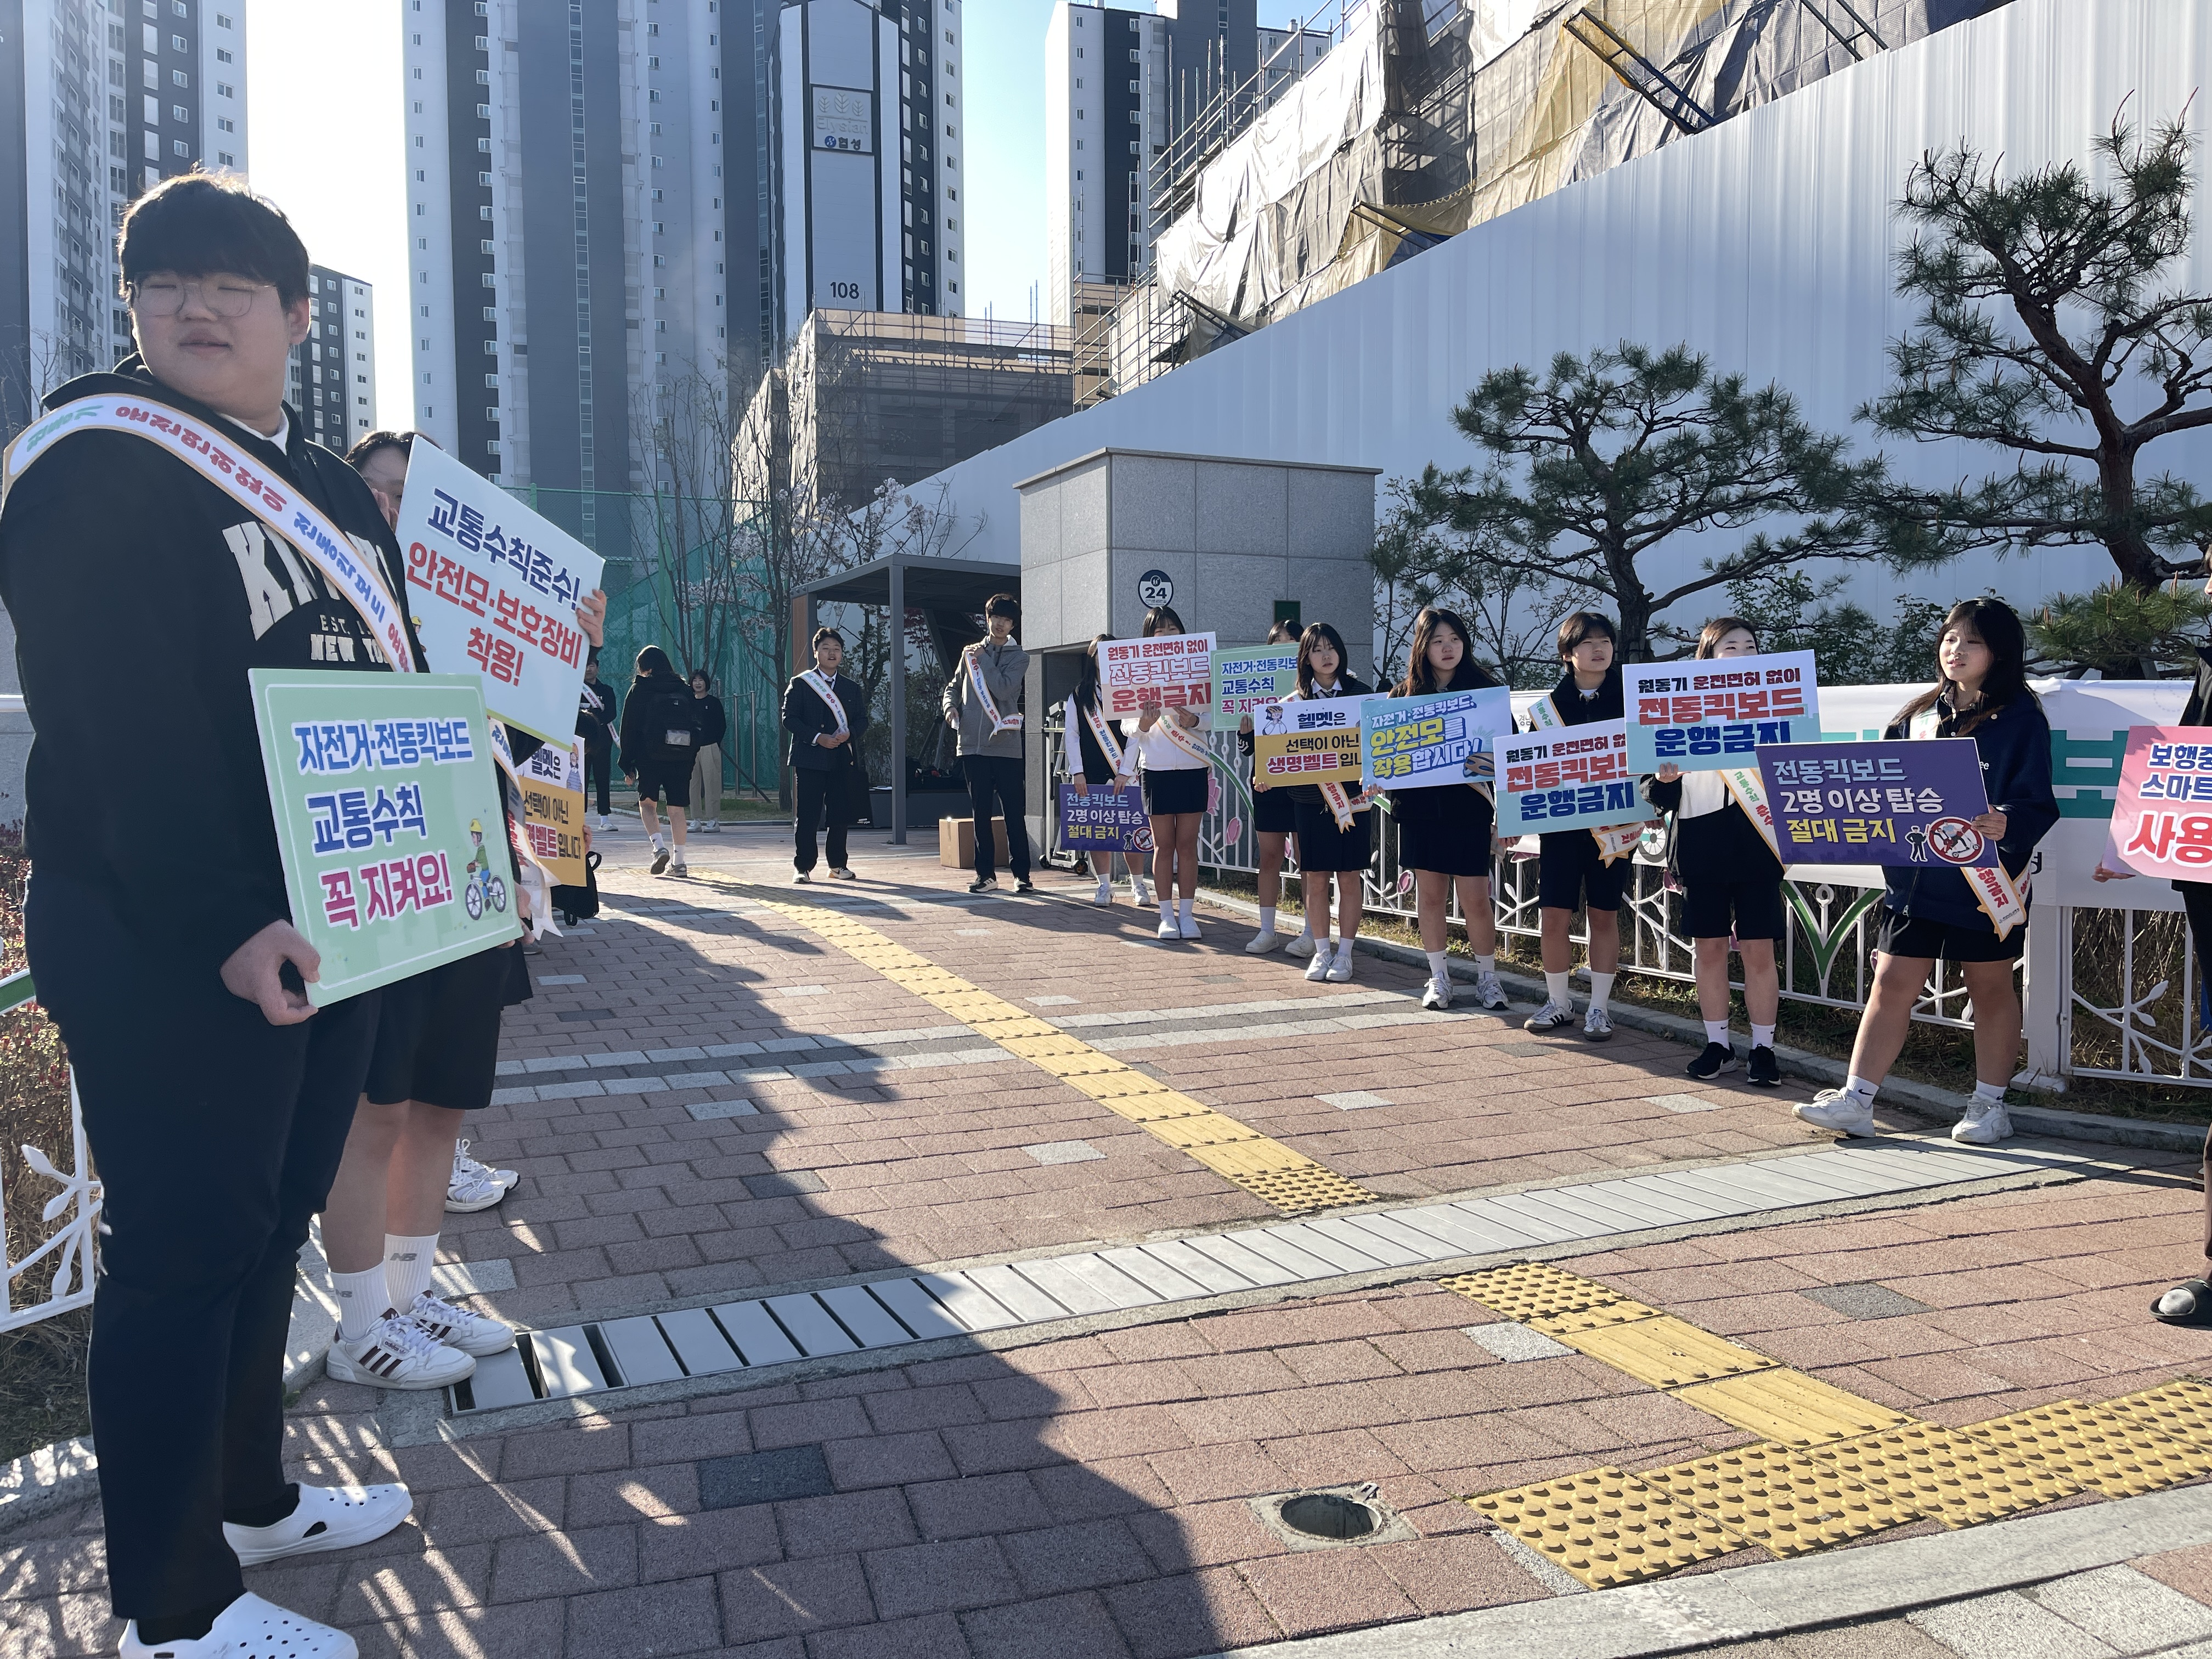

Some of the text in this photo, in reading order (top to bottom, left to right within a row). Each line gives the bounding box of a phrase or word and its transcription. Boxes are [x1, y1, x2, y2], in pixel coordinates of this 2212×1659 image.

[816, 117, 868, 134] Elysian
[838, 137, 861, 150] 협성
[831, 281, 860, 300] 108
[427, 488, 581, 611] 교통수칙준수!
[407, 542, 582, 670] 안전모·보호장비
[1145, 587, 1167, 599] 24
[320, 614, 350, 634] EST.
[311, 634, 389, 663] NEW YO
[467, 627, 524, 687] 착용!
[1108, 639, 1208, 661] 원동기 운전면허 없이
[1109, 656, 1210, 686] 전동킥보드
[1222, 657, 1298, 674] 자전거·전동킥보
[1222, 677, 1274, 695] 교통수칙
[1638, 668, 1801, 693] 원동기 운전면허 없이
[1112, 682, 1211, 713] 운행금지
[1222, 699, 1234, 714] 꼭
[1639, 687, 1804, 725] 전동킥보드
[1297, 712, 1346, 729] 헬멧은
[295, 721, 473, 772] 자전거·전동킥보드
[1285, 733, 1359, 753] 선택이 아닌
[1370, 716, 1465, 757] 안전모를
[1506, 733, 1626, 763] 원동기 운전면허 없
[1655, 721, 1791, 757] 운행금지
[1373, 738, 1481, 778] 착용합시다!
[2149, 744, 2212, 770] 보행중
[1773, 758, 1908, 785] 전동킥보드
[1066, 793, 1129, 807] 전동킥보드
[2140, 774, 2212, 801] 스마트
[552, 798, 568, 825] 아닌
[1521, 781, 1634, 821] 운행금지
[1780, 788, 1944, 814] 2명 이상 탑승
[307, 785, 426, 854] 교통수칙
[1067, 809, 1144, 824] 2명 이상 탑승
[1756, 804, 1773, 825] 준수
[1068, 825, 1119, 839] 절대 금지
[1786, 818, 1896, 843] 절대 금지
[2128, 815, 2212, 864] 사용
[321, 853, 452, 928] 꼭 지켜요!
[390, 1253, 417, 1261] NB
[385, 1341, 399, 1352] adidas
